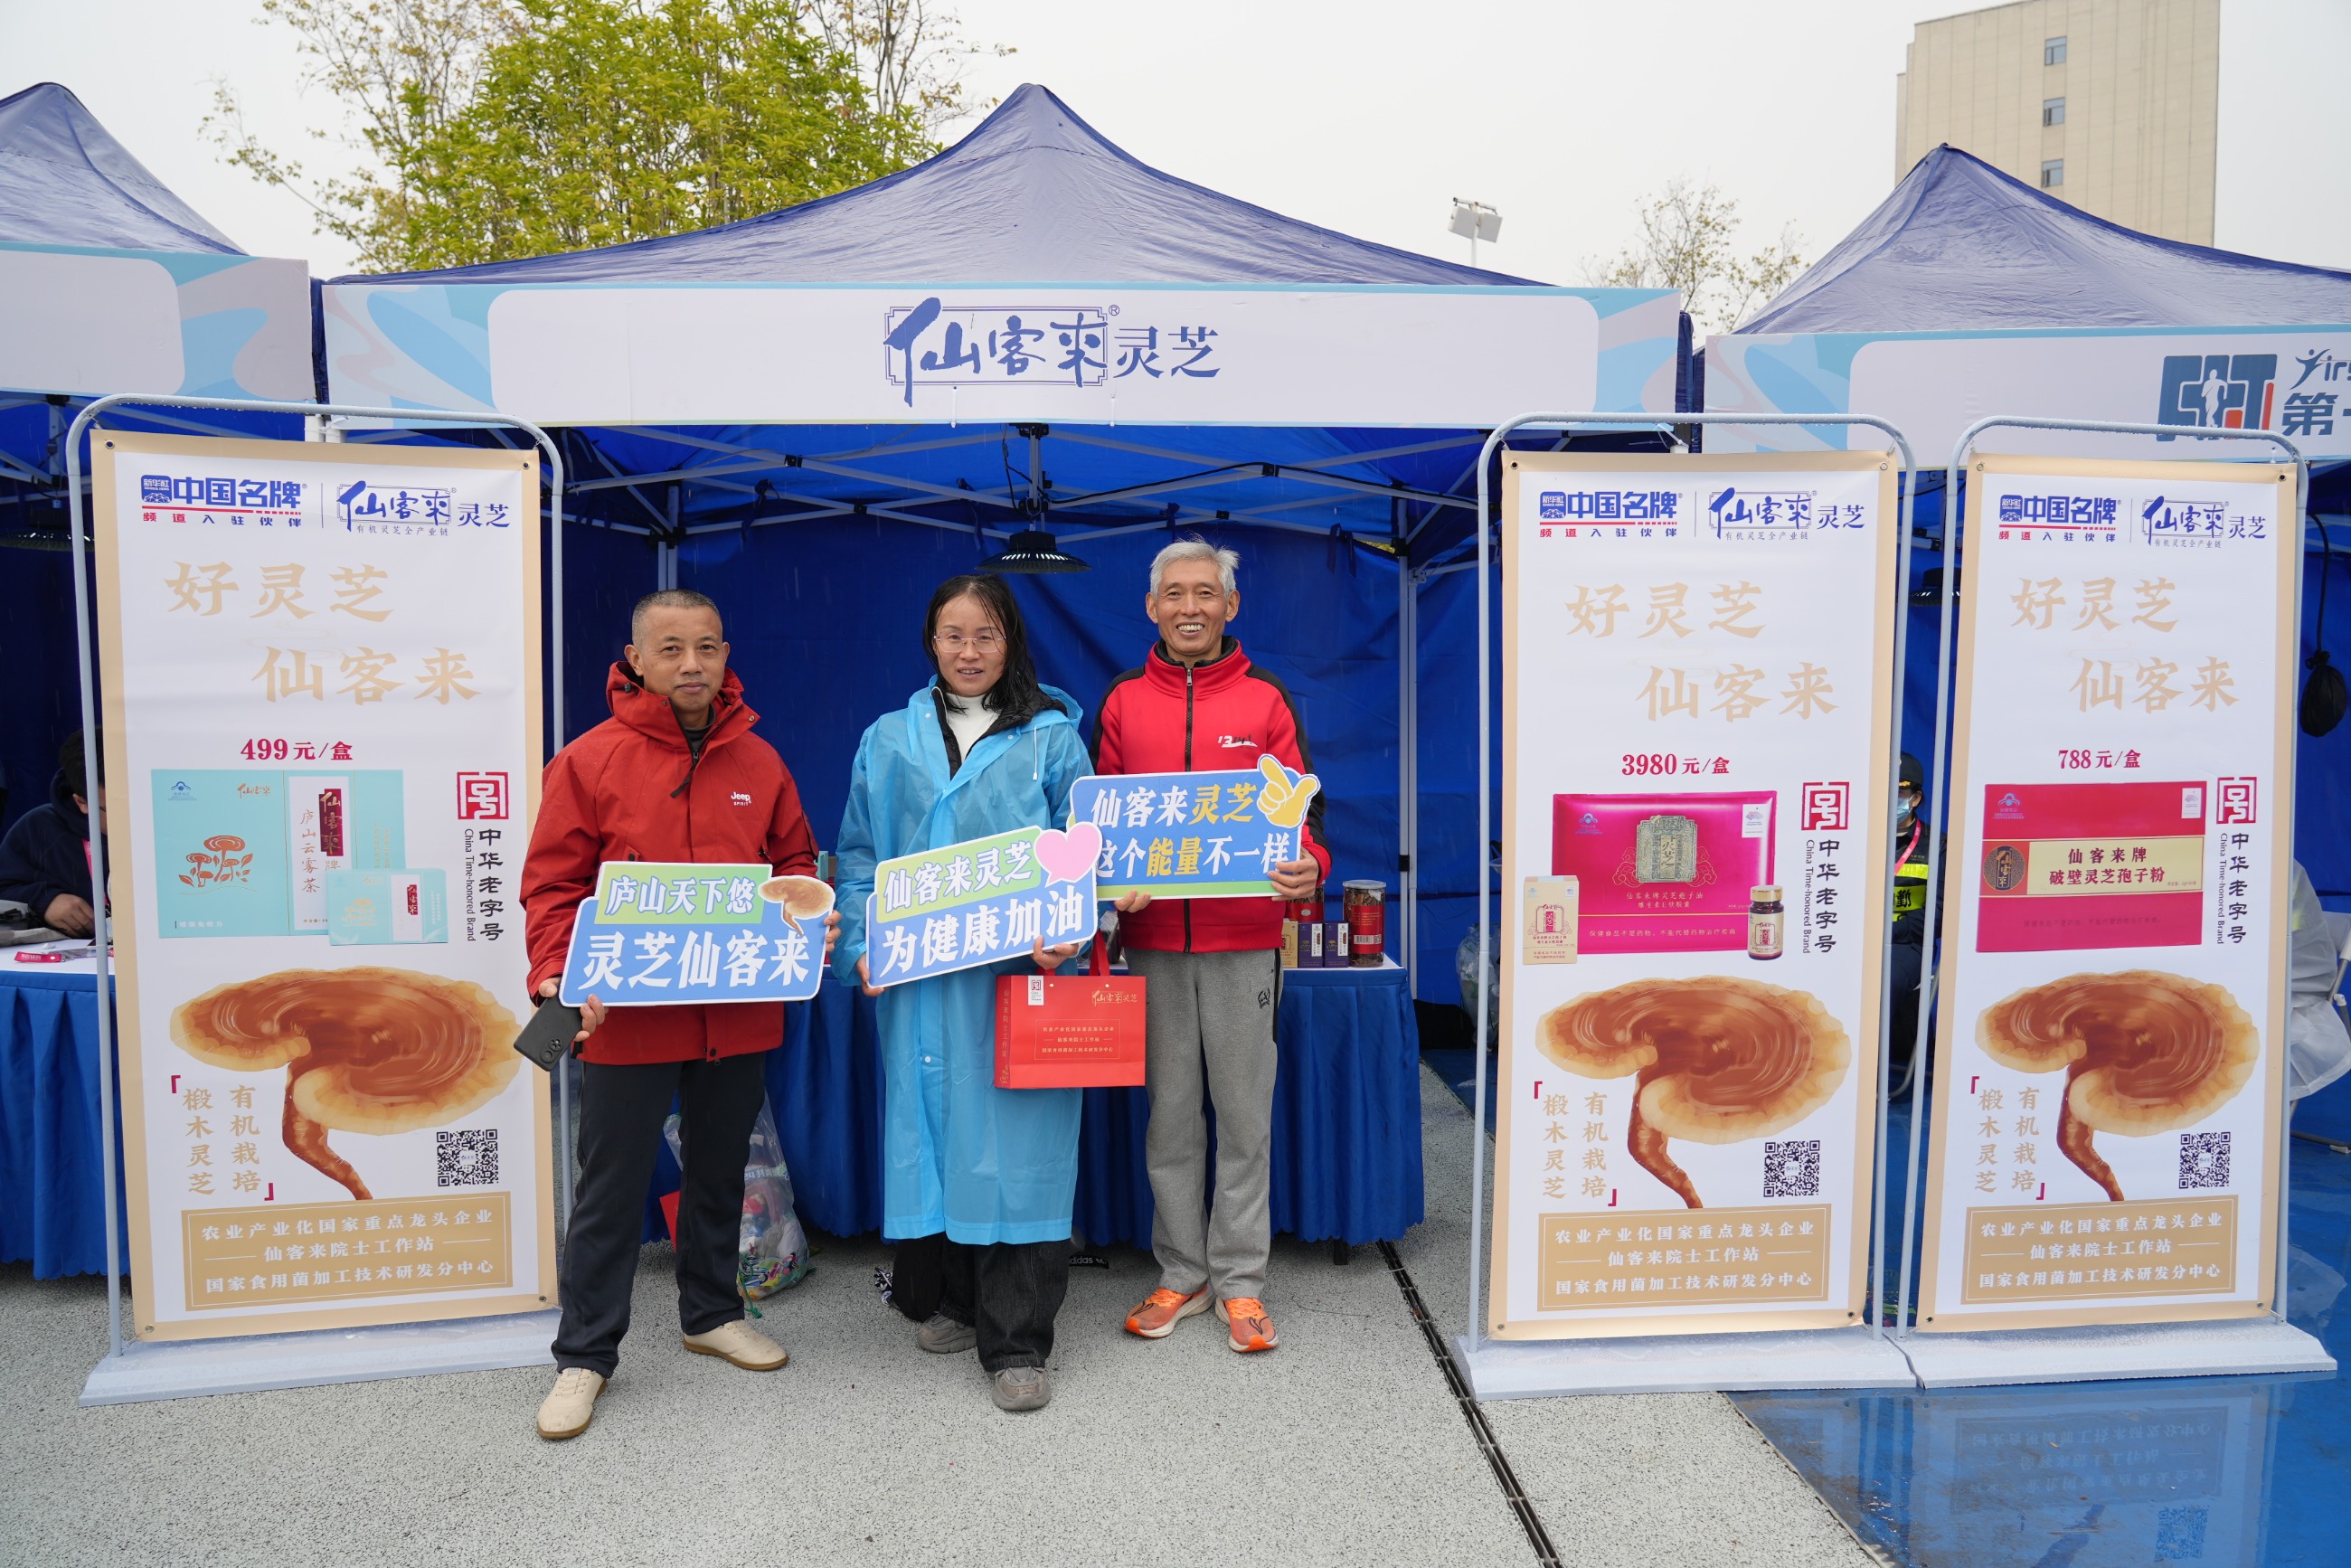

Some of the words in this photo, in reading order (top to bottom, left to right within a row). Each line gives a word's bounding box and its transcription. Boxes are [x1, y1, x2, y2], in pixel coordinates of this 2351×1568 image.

[174, 477, 300, 508] 中国名牌
[1567, 491, 1677, 519] 中国名牌
[143, 512, 301, 527] 频道入驻伙伴
[2024, 496, 2116, 524] 中国名牌
[357, 524, 448, 536] 有机灵芝全产业链
[1540, 528, 1677, 538] 频道入驻伙伴
[1725, 531, 1808, 541] 有机灵芝全产业链
[1998, 531, 2115, 542] 频道入驻伙伴
[2155, 539, 2222, 549] 有机灵芝全产业链
[165, 561, 395, 622] 好灵芝
[2010, 576, 2180, 633] 好灵芝
[1565, 580, 1766, 639] 好灵芝
[250, 646, 482, 705] 仙客来
[2070, 656, 2240, 714] 仙客来
[1636, 661, 1839, 723] 仙客来
[731, 791, 751, 802] Jeep
[1091, 782, 1258, 828] 仙客来灵芝
[465, 828, 474, 852] China
[1806, 839, 1815, 864] China
[2220, 833, 2228, 856] China
[1096, 832, 1290, 879] 这个能量不一样
[2068, 846, 2147, 864] 仙客来牌
[466, 855, 476, 914] Time-honored
[478, 829, 504, 941] 中华老字号
[883, 840, 1033, 913] 仙客来灵芝
[2049, 867, 2165, 885] 破壁灵芝孢子粉
[2218, 859, 2227, 918] Time-honored
[2227, 833, 2250, 944] 中华老字号
[607, 876, 756, 916] 庐山天下悠
[1804, 867, 1814, 927] Time-honored
[1815, 839, 1840, 953] 中华老字号
[1893, 890, 1912, 907] 勤
[467, 918, 476, 941] Brand
[880, 884, 1084, 978] 为健康加油
[1802, 929, 1812, 954] Brand
[2217, 921, 2225, 944] Brand
[578, 928, 810, 990] 灵芝仙客来
[230, 1083, 261, 1195] 有机栽培
[1581, 1091, 1609, 1198] 有机栽培
[2011, 1086, 2040, 1192] 有机栽培
[202, 1209, 493, 1241] 农业产业化国家重点龙头企业
[1555, 1221, 1814, 1244] 农业产业化国家重点龙头企业
[1981, 1212, 2222, 1237] 农业产业化国家重点龙头企业
[264, 1236, 435, 1262] 仙客来院士工作站
[1068, 1256, 1093, 1264] didas
[1608, 1246, 1760, 1267] 仙客来院士工作站
[2029, 1239, 2172, 1260] 仙客来院士工作站
[206, 1260, 494, 1293] 国家食用菌加工技术研发分中心
[1556, 1271, 1812, 1295] 国家食用菌加工技术研发分中心
[1979, 1263, 2221, 1289] 国家食用菌加工技术研发分中心
